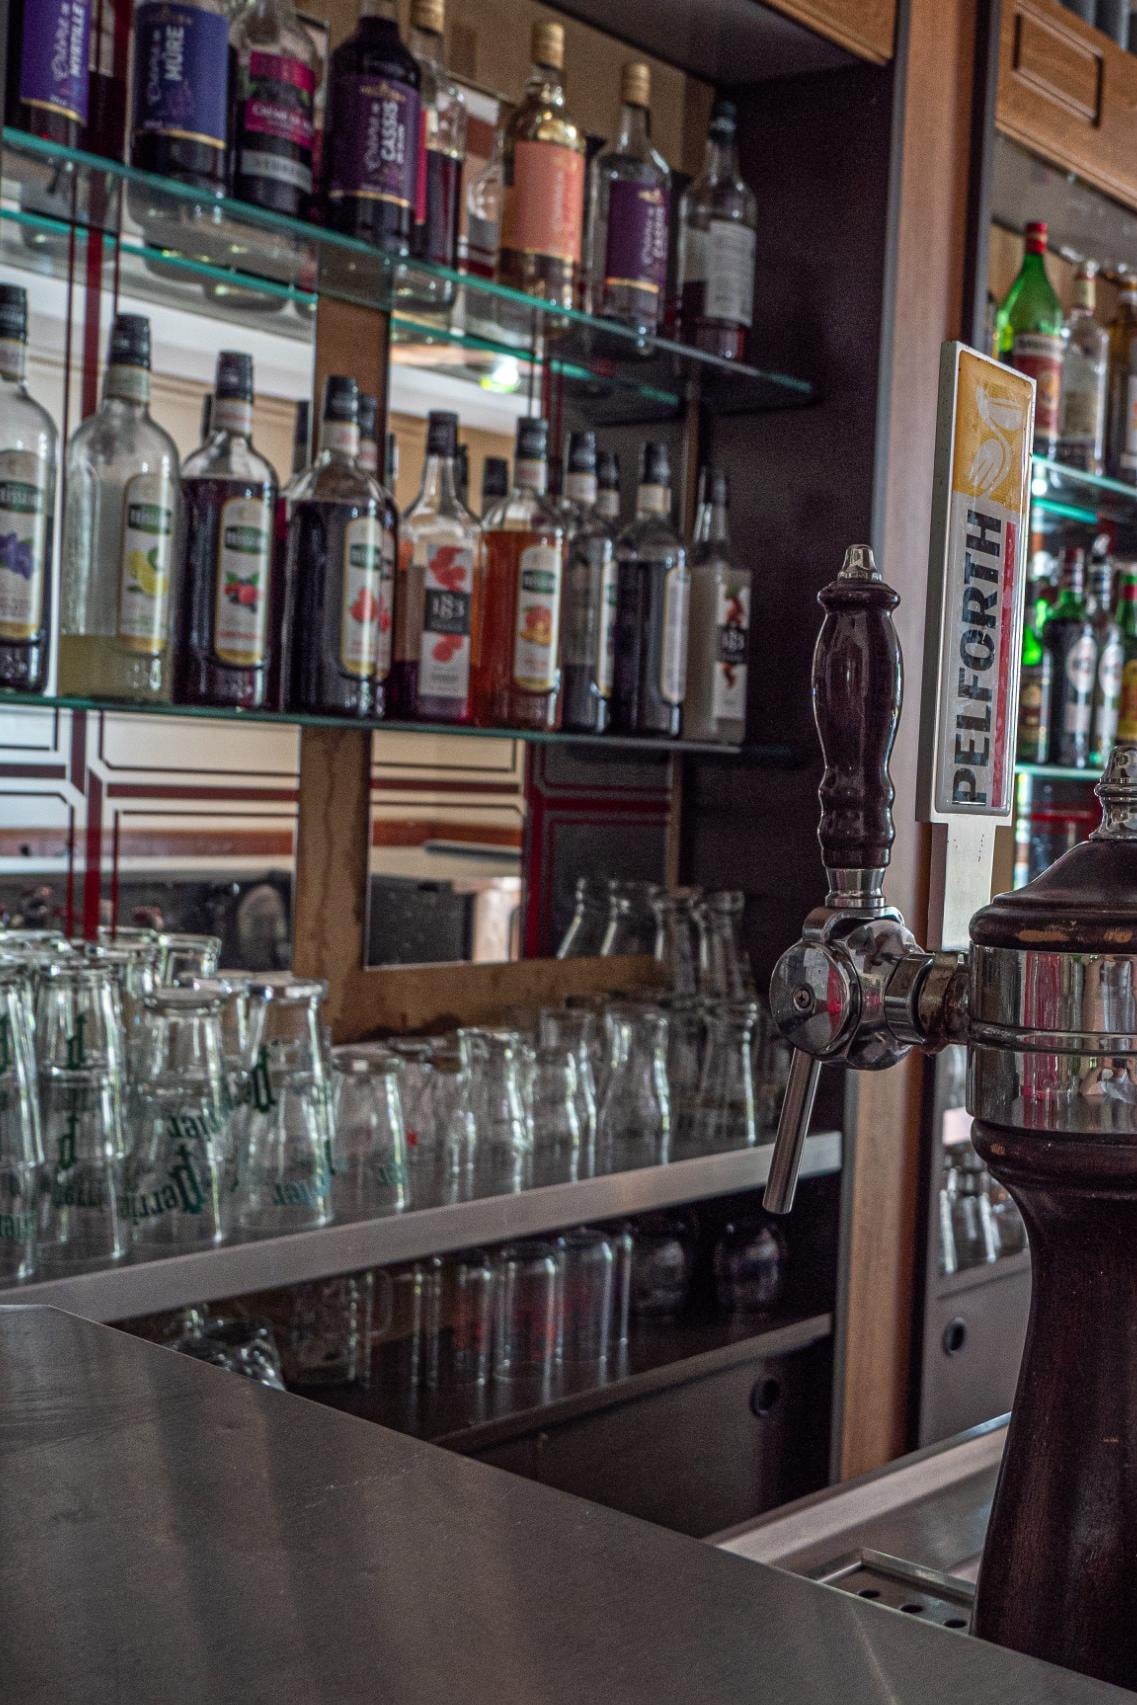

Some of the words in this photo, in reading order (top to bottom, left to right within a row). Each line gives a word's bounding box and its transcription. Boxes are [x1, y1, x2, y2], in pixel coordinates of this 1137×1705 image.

[161, 25, 185, 80] MÛRE
[381, 100, 399, 161] CASSIS
[952, 508, 1001, 806] PELFORTH
